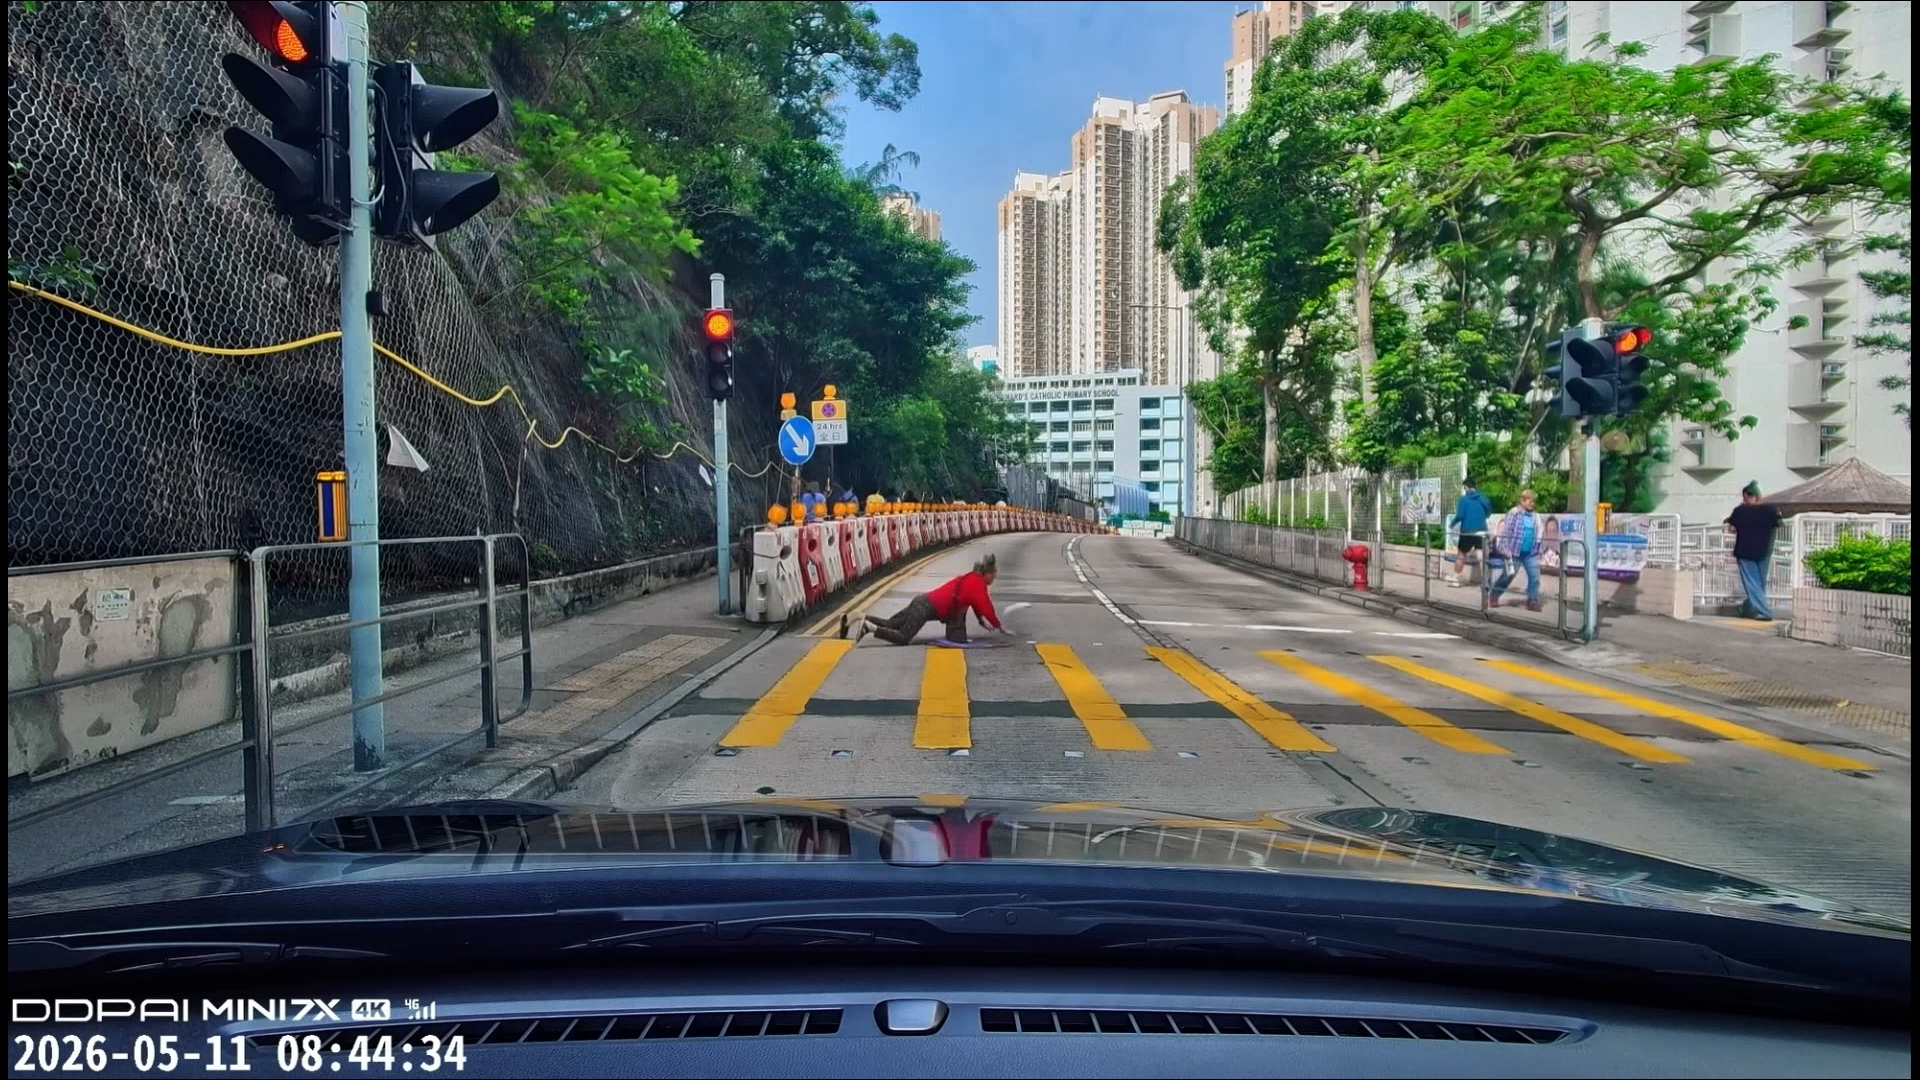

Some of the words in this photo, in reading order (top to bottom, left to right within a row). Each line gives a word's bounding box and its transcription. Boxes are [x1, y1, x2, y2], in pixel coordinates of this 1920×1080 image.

[1030, 391, 1061, 400] CATHOLIC
[1063, 390, 1091, 399] PRIMARY
[1094, 389, 1119, 398] SCHOOL
[820, 432, 840, 441] 全日
